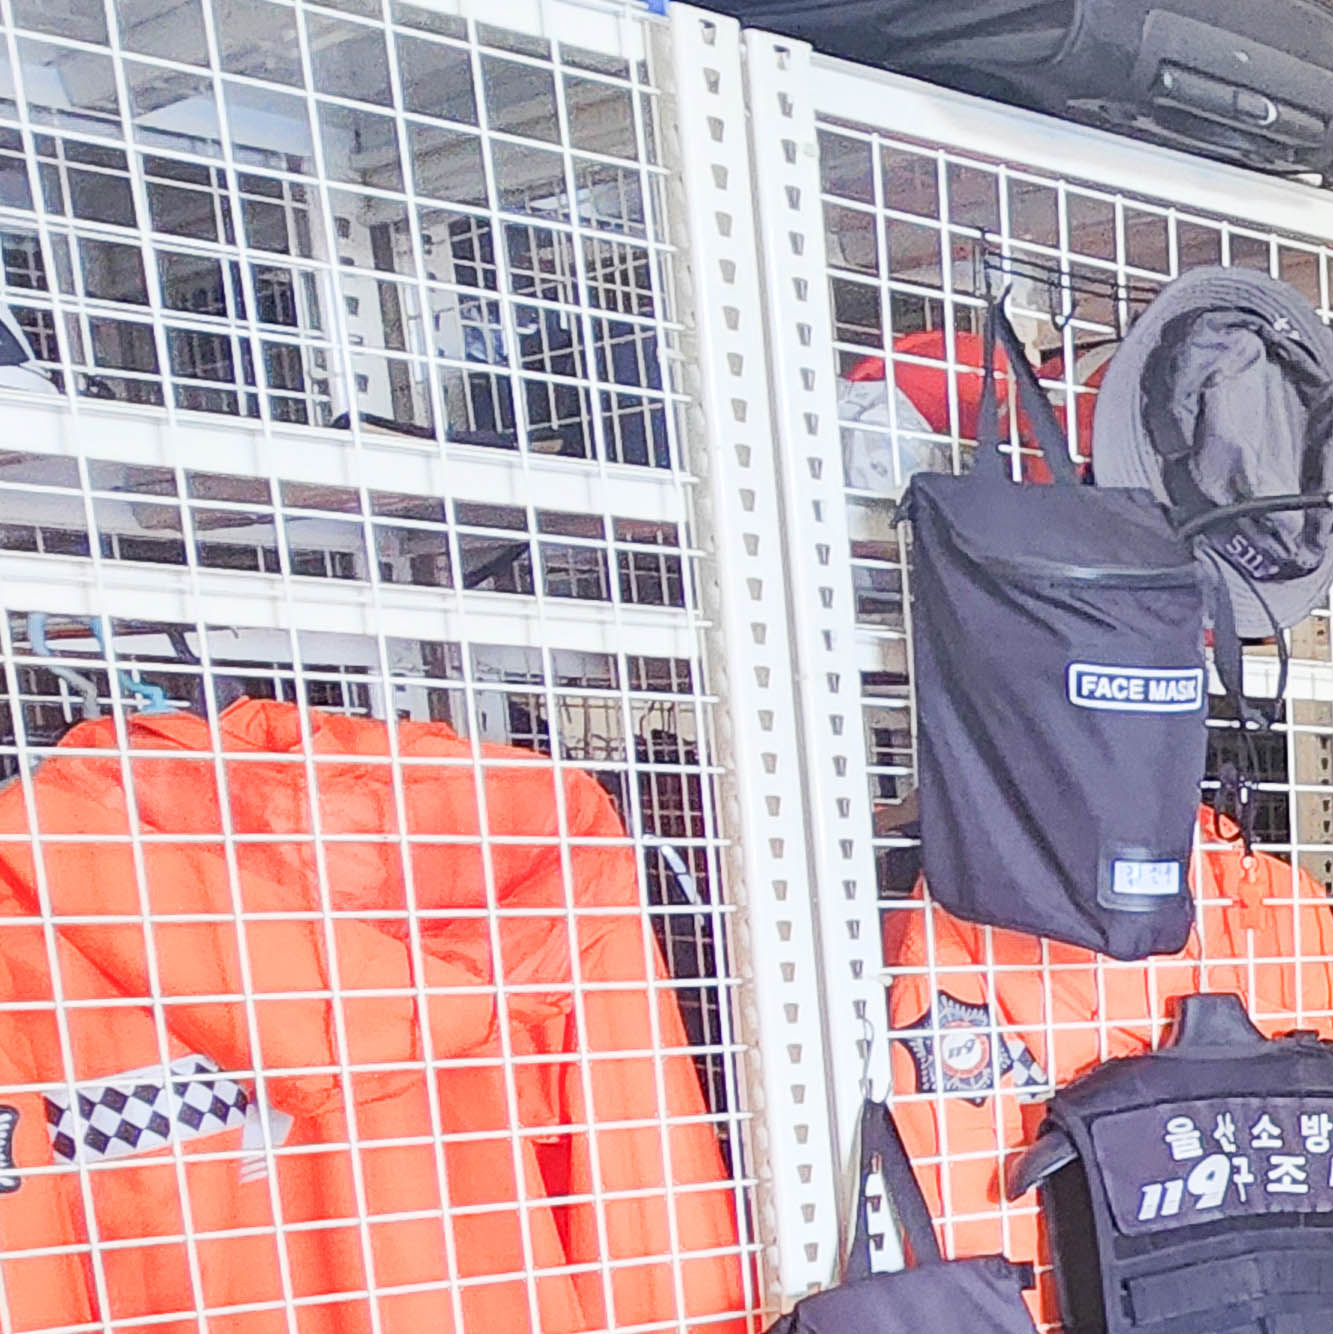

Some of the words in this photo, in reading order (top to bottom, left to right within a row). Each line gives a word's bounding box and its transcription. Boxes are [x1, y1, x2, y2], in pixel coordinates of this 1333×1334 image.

[1080, 675, 1145, 701] FACE
[1148, 679, 1197, 702] MASK
[1164, 1111, 1333, 1161] 울산소방
